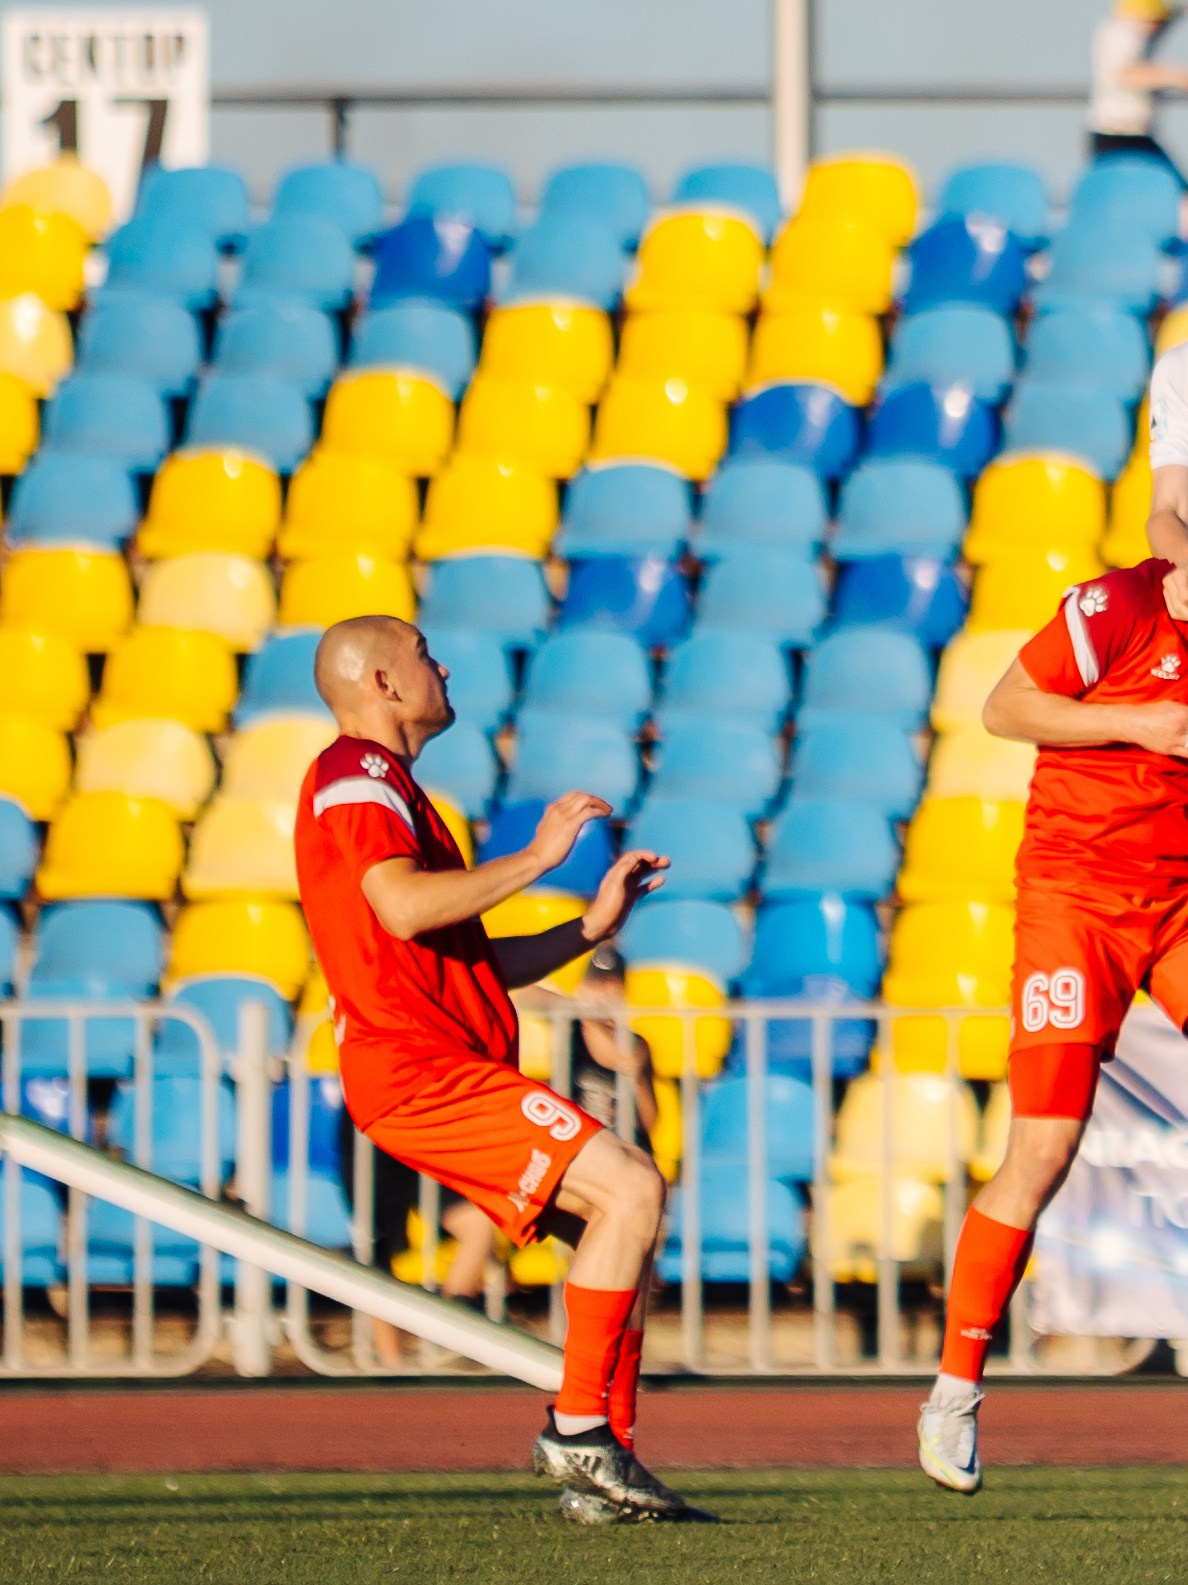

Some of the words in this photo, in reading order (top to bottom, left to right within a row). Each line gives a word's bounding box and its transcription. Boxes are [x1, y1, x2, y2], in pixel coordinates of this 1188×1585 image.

[37, 98, 169, 172] 17
[1022, 968, 1085, 1033] 69
[521, 1091, 582, 1141] 9
